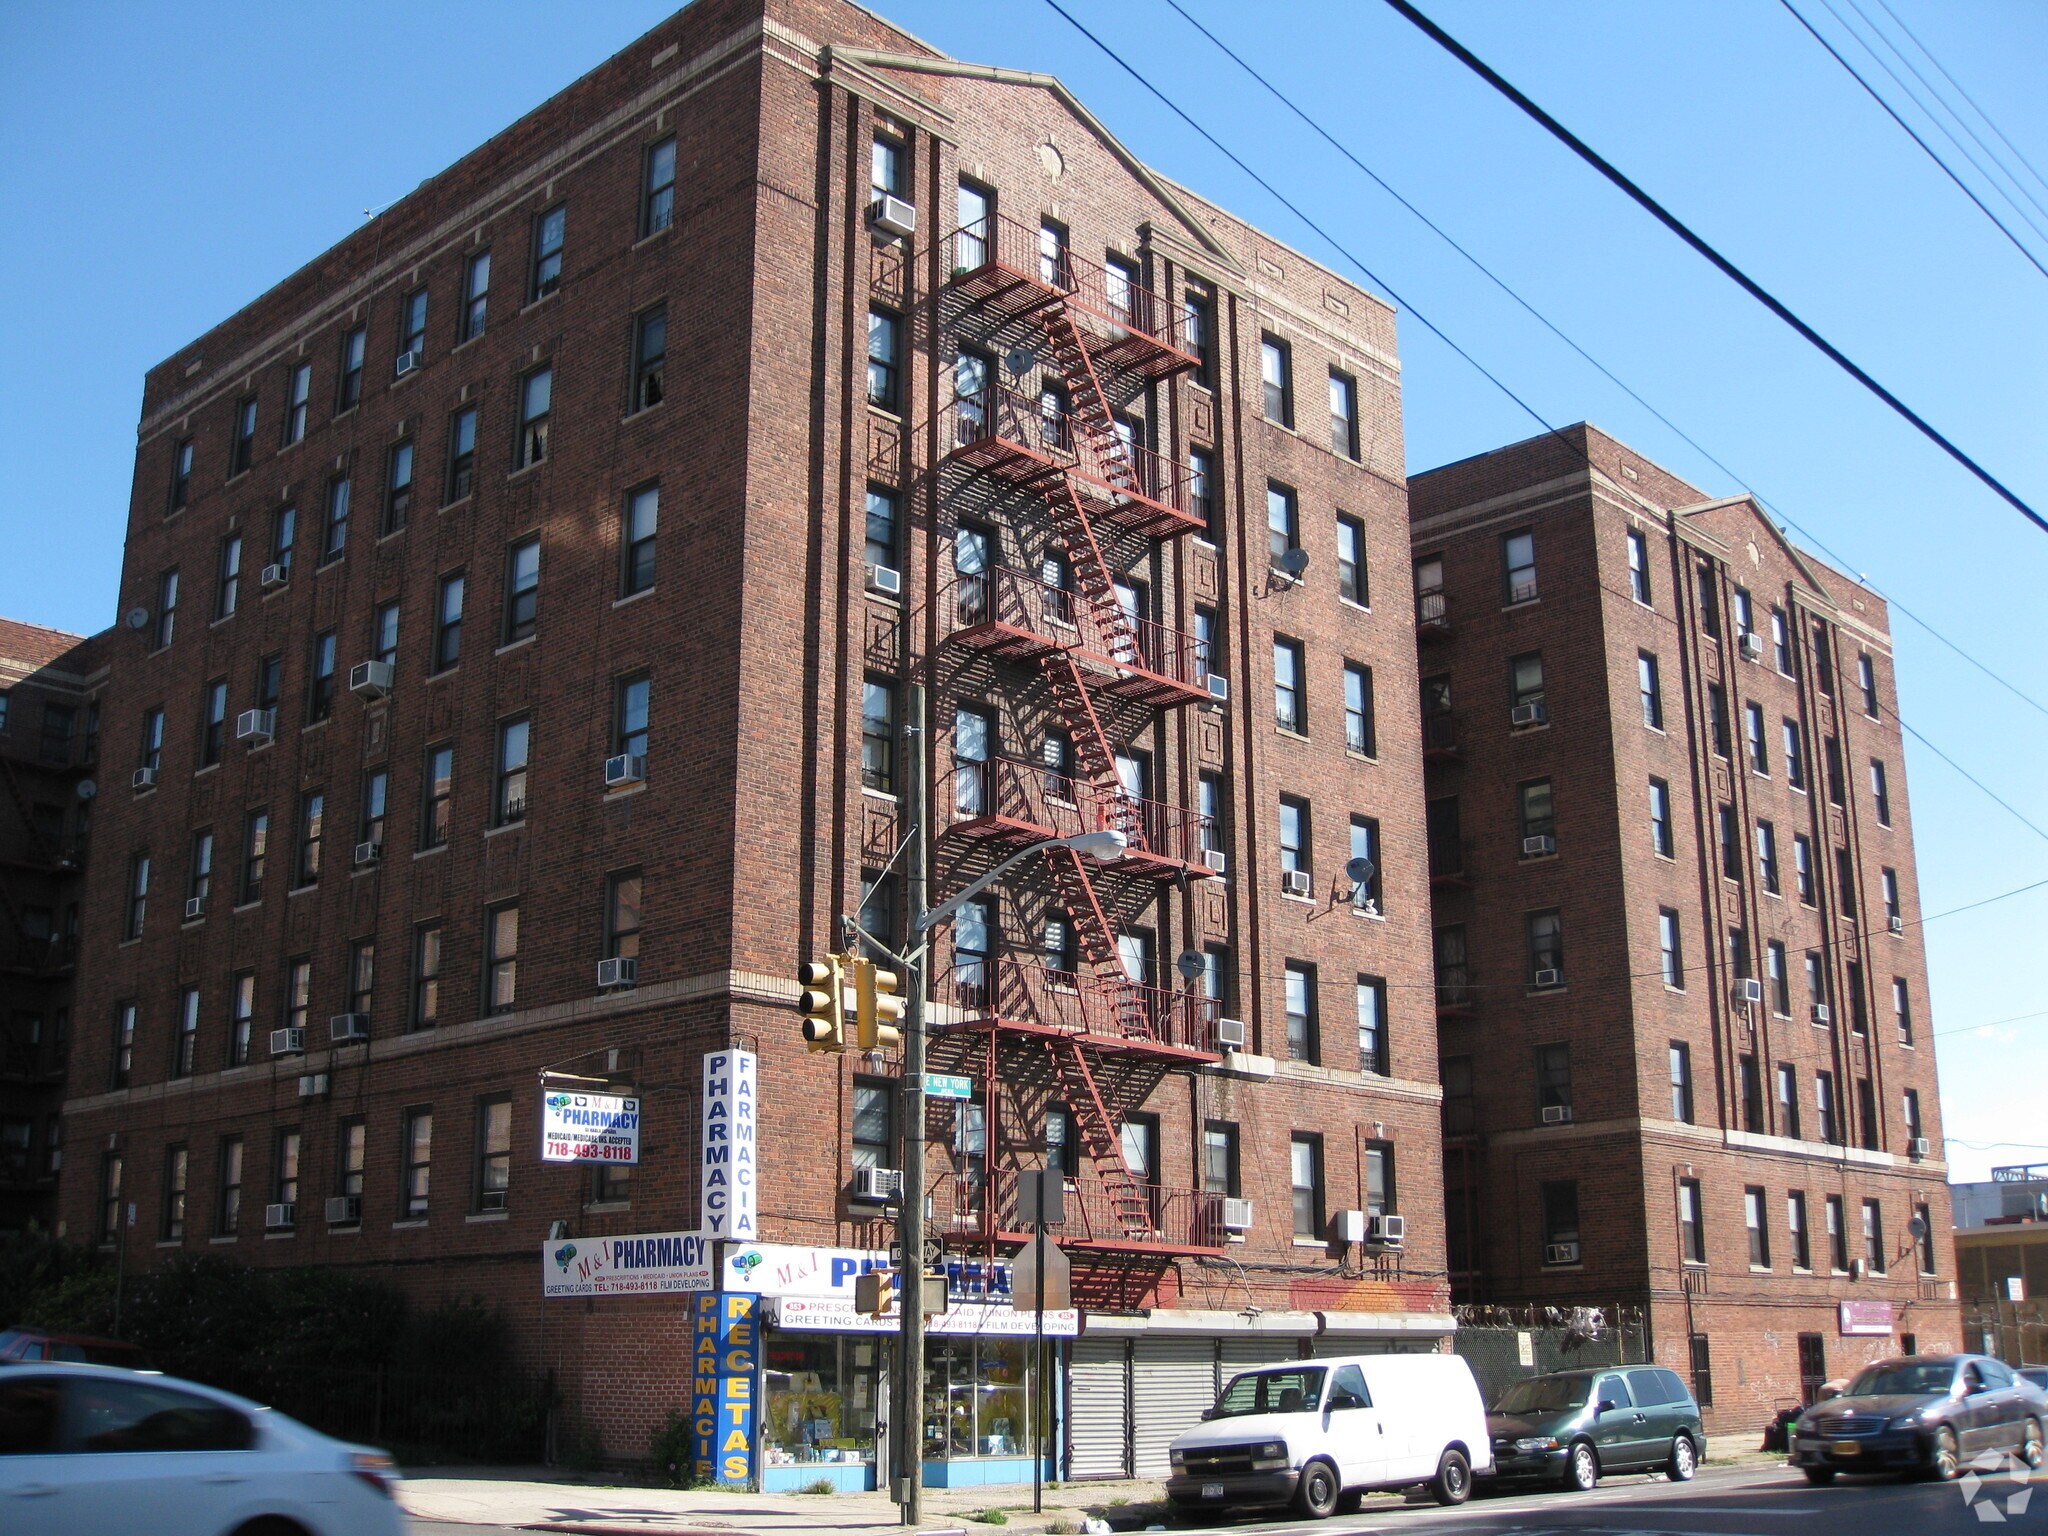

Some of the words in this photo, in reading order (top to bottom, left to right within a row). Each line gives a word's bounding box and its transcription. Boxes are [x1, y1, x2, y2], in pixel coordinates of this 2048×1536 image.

[934, 1077, 947, 1087] NEW
[950, 1078, 969, 1090] YORK
[591, 1096, 601, 1108] M
[563, 1109, 639, 1129] PHARMACY
[608, 1136, 632, 1145] ACCEPTED
[706, 1056, 729, 1233] PHARMACY
[736, 1057, 753, 1231] FARMACIA
[547, 1142, 632, 1160] 718-493-8118
[613, 1236, 705, 1269] PHARMACY
[577, 1256, 592, 1283] M
[593, 1253, 603, 1270] &
[642, 1272, 666, 1280] MEDICAID
[777, 1263, 793, 1287] M
[797, 1265, 808, 1279] &
[546, 1284, 575, 1294] GREETING
[575, 1283, 592, 1293] CARDS
[594, 1283, 609, 1292] TEL:
[611, 1281, 658, 1292] 718-493-8118
[660, 1280, 673, 1290] FILM
[673, 1278, 710, 1289] DEVELOPING
[784, 1314, 852, 1326] GREETING
[856, 1316, 893, 1327] CARDS
[986, 1321, 1008, 1330] FILM
[1010, 1322, 1075, 1332] DEVEOPING
[722, 1296, 752, 1479] RECETAS
